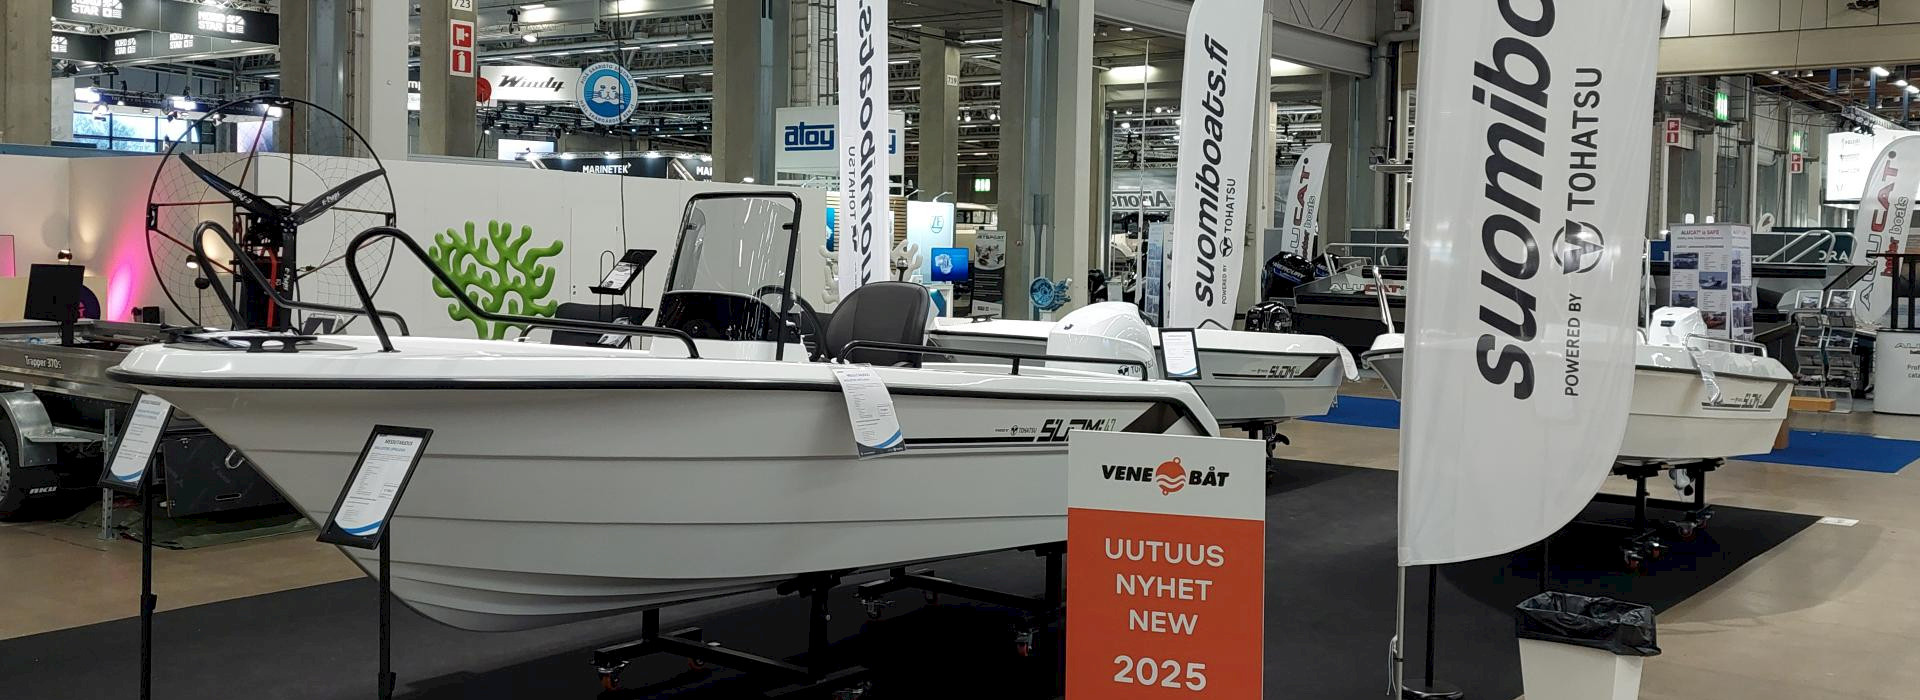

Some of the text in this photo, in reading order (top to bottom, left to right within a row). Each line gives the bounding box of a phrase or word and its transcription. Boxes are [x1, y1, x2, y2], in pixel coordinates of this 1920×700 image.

[71, 4, 99, 17] STAR
[197, 11, 226, 23] NORD
[197, 20, 225, 33] STAR
[115, 38, 128, 47] NORD
[115, 46, 127, 55] STAR
[169, 40, 183, 49] STAR
[498, 75, 565, 92] Windy
[785, 122, 835, 152] atoy
[582, 165, 629, 174] MARINETEK
[1195, 34, 1229, 307] suomiboats.fi
[1224, 178, 1236, 233] TOHATSU
[1889, 195, 1909, 237] boats
[1565, 67, 1602, 397] POWERED BY TOHATSU
[1222, 264, 1227, 273] BY
[1272, 261, 1306, 279] MERCURY
[24, 355, 46, 368] Trapper
[1101, 464, 1230, 487] VENE BÅT
[1105, 537, 1225, 567] UUTUUS
[1116, 573, 1213, 601] NYHET
[1129, 609, 1199, 635] NEW
[1113, 655, 1207, 692] 2025
